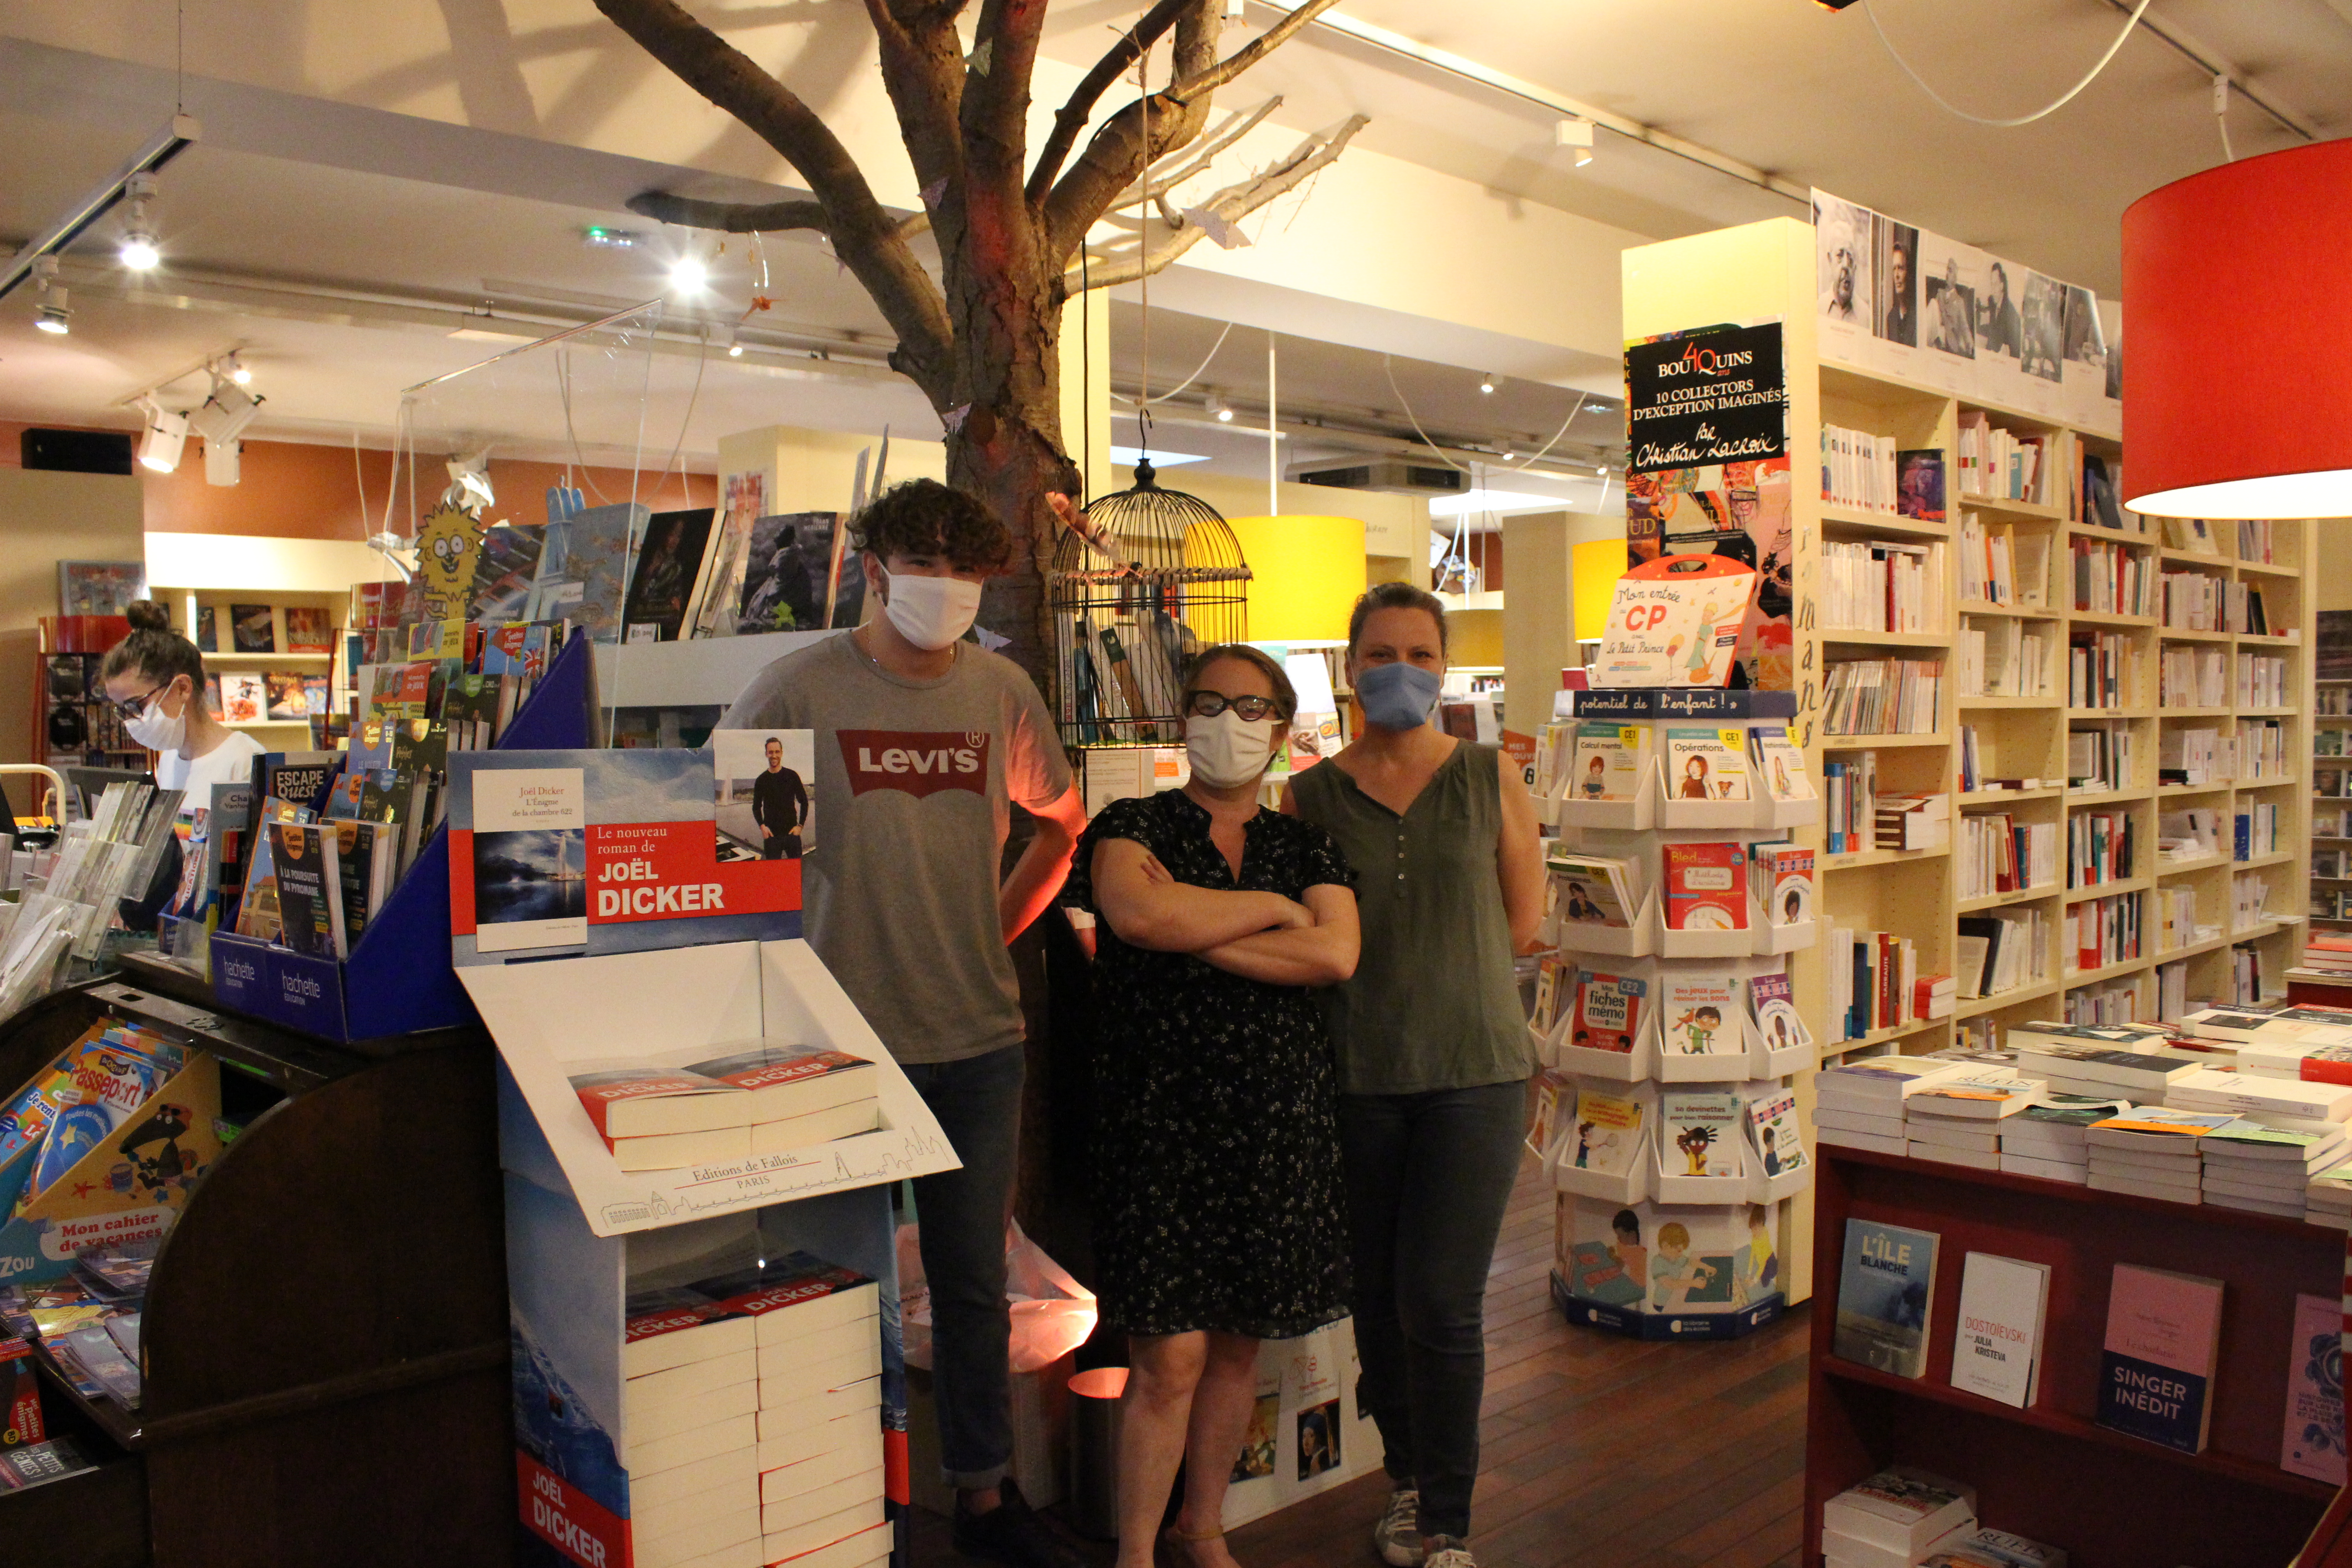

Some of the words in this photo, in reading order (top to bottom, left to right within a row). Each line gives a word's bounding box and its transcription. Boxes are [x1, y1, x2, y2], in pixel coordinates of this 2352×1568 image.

[1656, 392, 1669, 404] 10
[1671, 379, 1754, 403] COLLECTORS
[1633, 399, 1715, 421] D'EXCEPTION
[1718, 387, 1782, 409] IMAGINÉS
[1636, 441, 1706, 467] Christian
[1707, 432, 1779, 458] Lacroix
[1617, 587, 1646, 604] Mon
[1650, 585, 1681, 603] entrée
[1626, 605, 1667, 631] CP
[1607, 642, 1614, 654] Le
[1618, 642, 1636, 654] Petit
[1638, 641, 1664, 653] Prince
[1579, 695, 1628, 712] potentiel
[1633, 695, 1648, 709] de
[1661, 695, 1717, 715] l'enfant
[1624, 730, 1636, 739] CE1
[1726, 733, 1740, 741] CE1
[1674, 743, 1725, 753] Opérations
[276, 770, 324, 786] ESCAPE
[278, 783, 318, 803] Quest
[519, 787, 536, 798] Joël
[538, 787, 565, 795] Dicker
[526, 797, 559, 807] L'Énigme
[597, 827, 612, 839] Le
[616, 827, 667, 839] nouveau
[597, 844, 637, 856] roman
[641, 840, 656, 853] de
[1671, 851, 1698, 862] Bled
[284, 869, 291, 878] LA
[291, 870, 319, 883] POURSUITE
[597, 858, 659, 883] JOËL
[283, 882, 291, 892] DU
[291, 884, 319, 897] PYROMANE
[598, 883, 725, 917] DICKER
[224, 956, 255, 981] hachette
[282, 970, 320, 999] hachette
[1620, 980, 1639, 994] CE2
[1689, 986, 1708, 995] jeux
[1590, 990, 1626, 1008] fiches
[1588, 1005, 1625, 1019] mémo
[738, 1061, 826, 1089] DICKER
[27, 1092, 39, 1104] Je
[597, 1082, 692, 1099] DICKER
[692, 1160, 743, 1183] Editions
[745, 1160, 760, 1172] de
[760, 1153, 798, 1171] Fallois
[736, 1174, 770, 1190] PARIS
[61, 1222, 100, 1238] Mon
[104, 1212, 160, 1231] cahier
[59, 1238, 80, 1253] de
[85, 1226, 163, 1249] vacances
[1862, 1233, 1911, 1265] L'ÎLE
[1860, 1254, 1908, 1276] BLANCHE
[744, 1282, 835, 1313] DICKER
[1965, 1316, 2026, 1344] DOSTOÏEVSKI
[1974, 1335, 1992, 1348] JULIA
[1975, 1347, 2006, 1362] KRISTEVA
[2114, 1366, 2187, 1401] SINGER
[2115, 1390, 2181, 1421] INÉDIT
[17, 1401, 29, 1440] énigmes
[24, 1406, 40, 1439] petites
[8, 1430, 16, 1443] BD
[36, 1451, 65, 1473] PETITS
[533, 1470, 566, 1509] JOËL
[533, 1496, 607, 1568] DICKER
